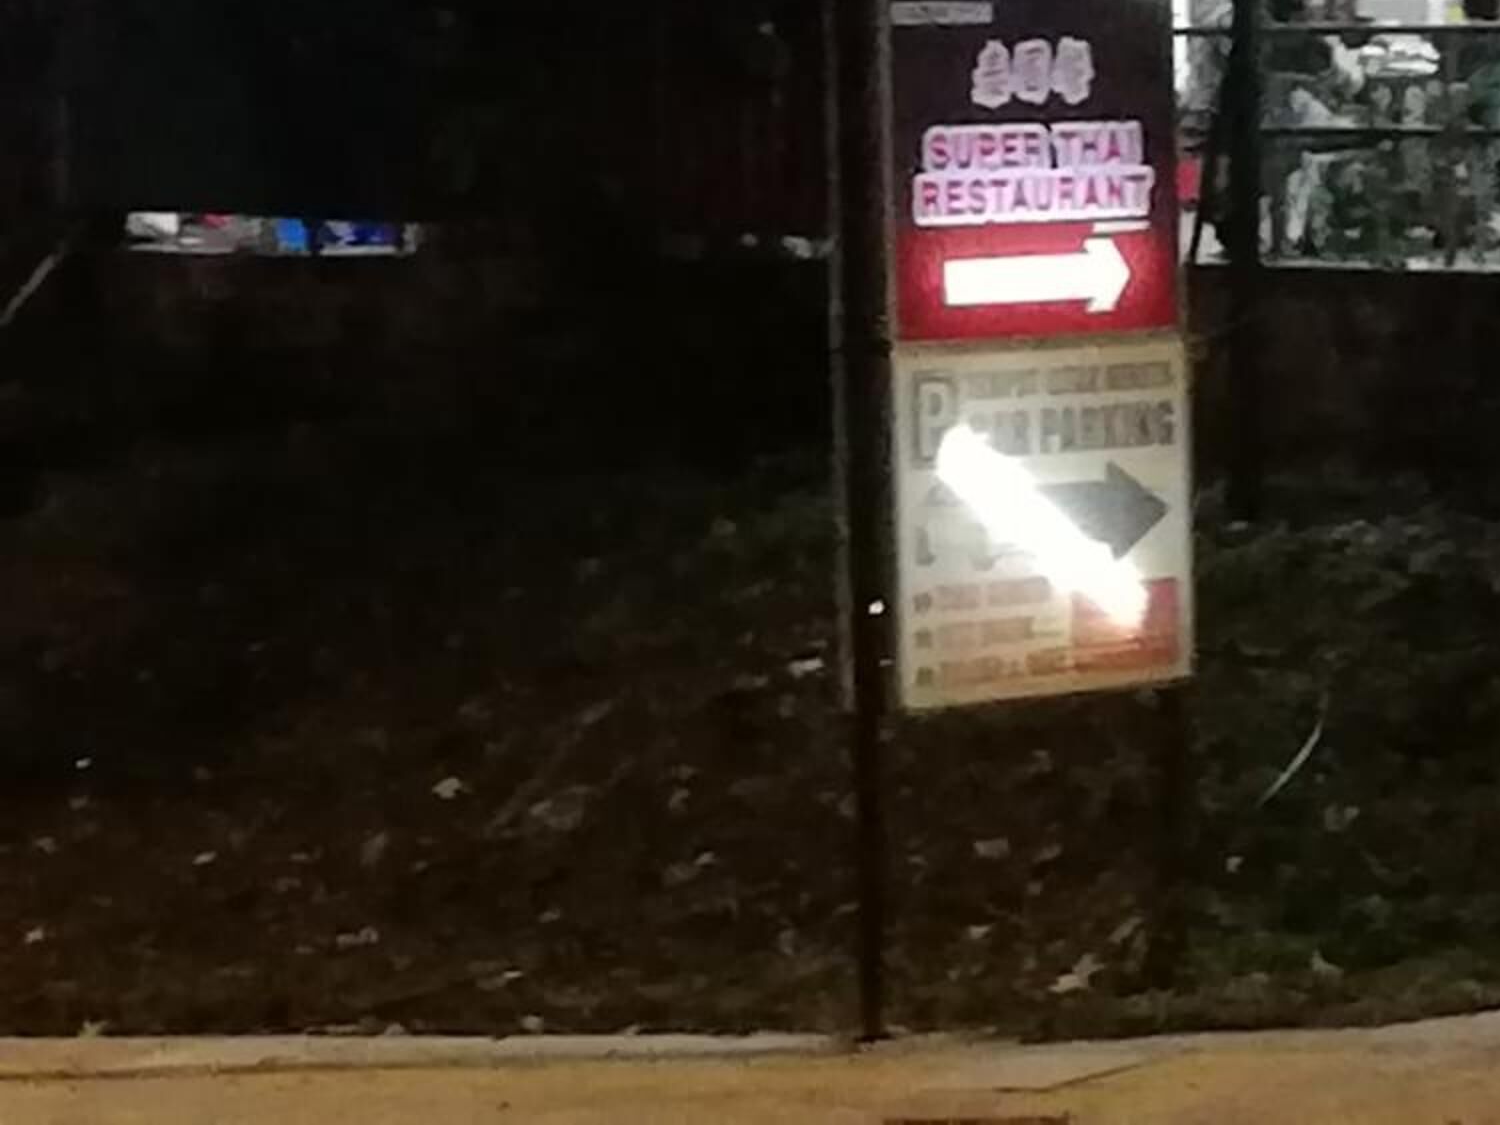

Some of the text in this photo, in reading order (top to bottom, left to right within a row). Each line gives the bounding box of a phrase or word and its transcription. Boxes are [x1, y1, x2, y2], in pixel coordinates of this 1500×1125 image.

[926, 127, 1143, 172] SUPER THAI
[918, 172, 1148, 218] RESTAURANT
[1039, 398, 1177, 454] PARKING
